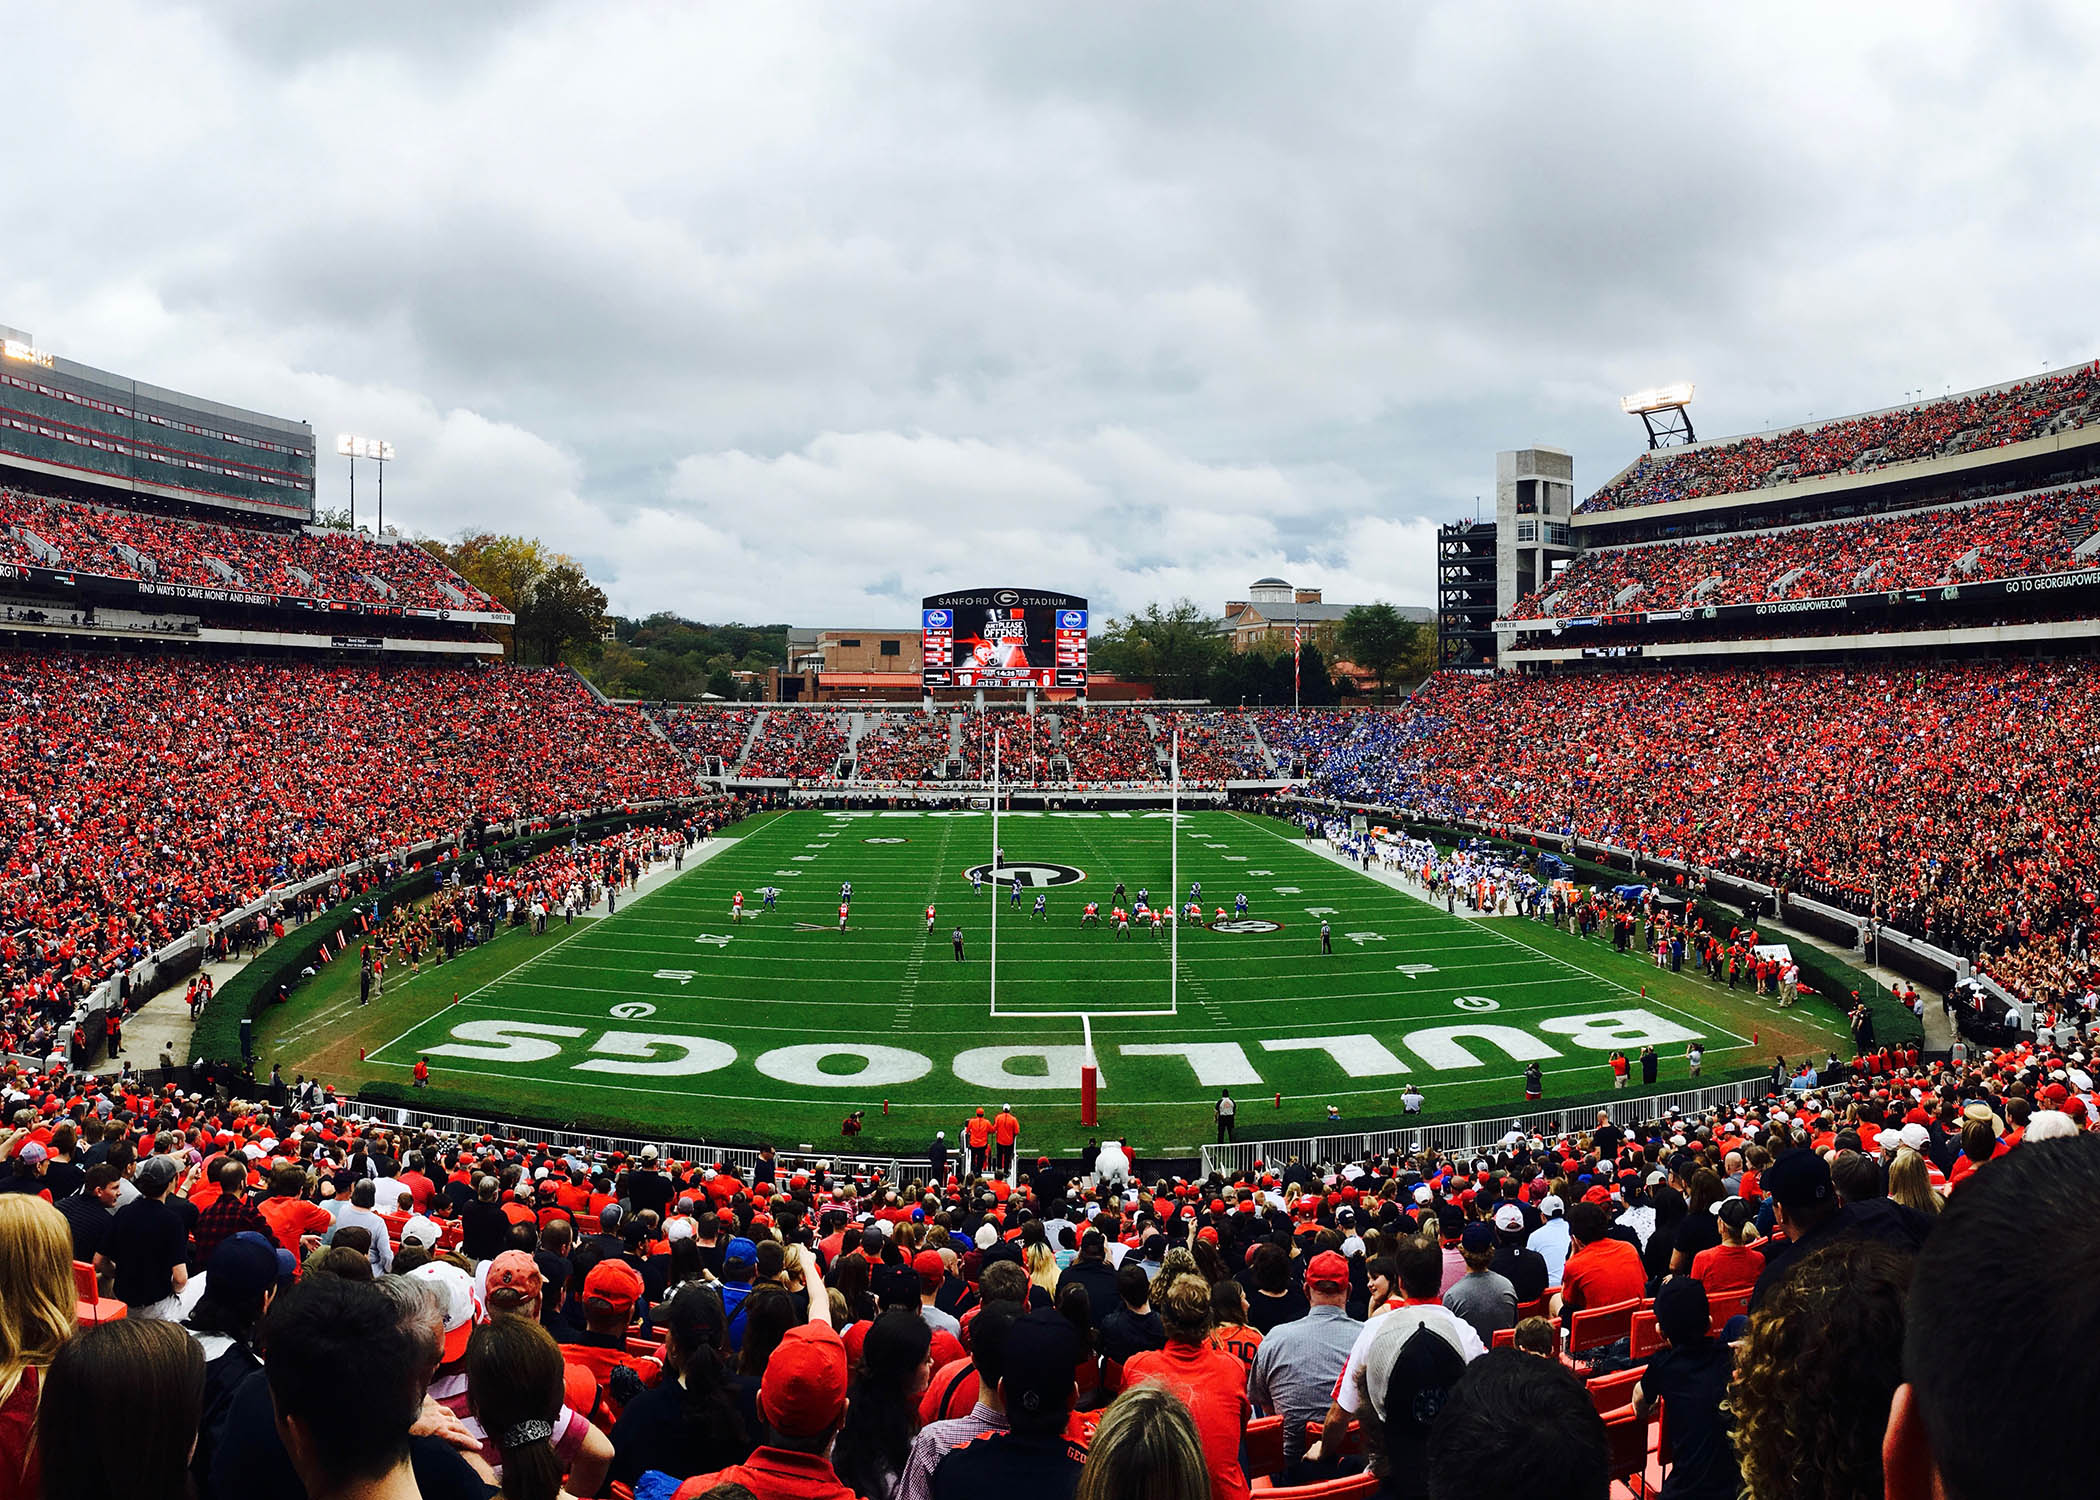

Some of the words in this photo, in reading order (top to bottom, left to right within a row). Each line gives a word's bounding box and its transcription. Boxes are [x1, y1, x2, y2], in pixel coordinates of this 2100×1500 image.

[2006, 582, 2019, 592] GO
[2021, 580, 2033, 591] TO
[138, 583, 155, 594] FIND
[156, 585, 175, 596] WAYS
[176, 587, 186, 597] TO
[187, 588, 203, 599] SAVE
[204, 590, 229, 601] MONEY
[229, 593, 244, 602] AND
[938, 597, 990, 606] SANFORD
[1022, 598, 1067, 606] STADIUM
[1756, 605, 1767, 614] GO
[1768, 604, 1777, 614] TO
[1778, 599, 1847, 613] GEORGIAPOWER.COM
[999, 621, 1023, 629] PLEASE
[1495, 621, 1517, 629] NORTH
[984, 629, 1024, 637] OFFENSE
[958, 673, 972, 687] 10
[417, 1008, 1706, 1088] BULLDOGS
